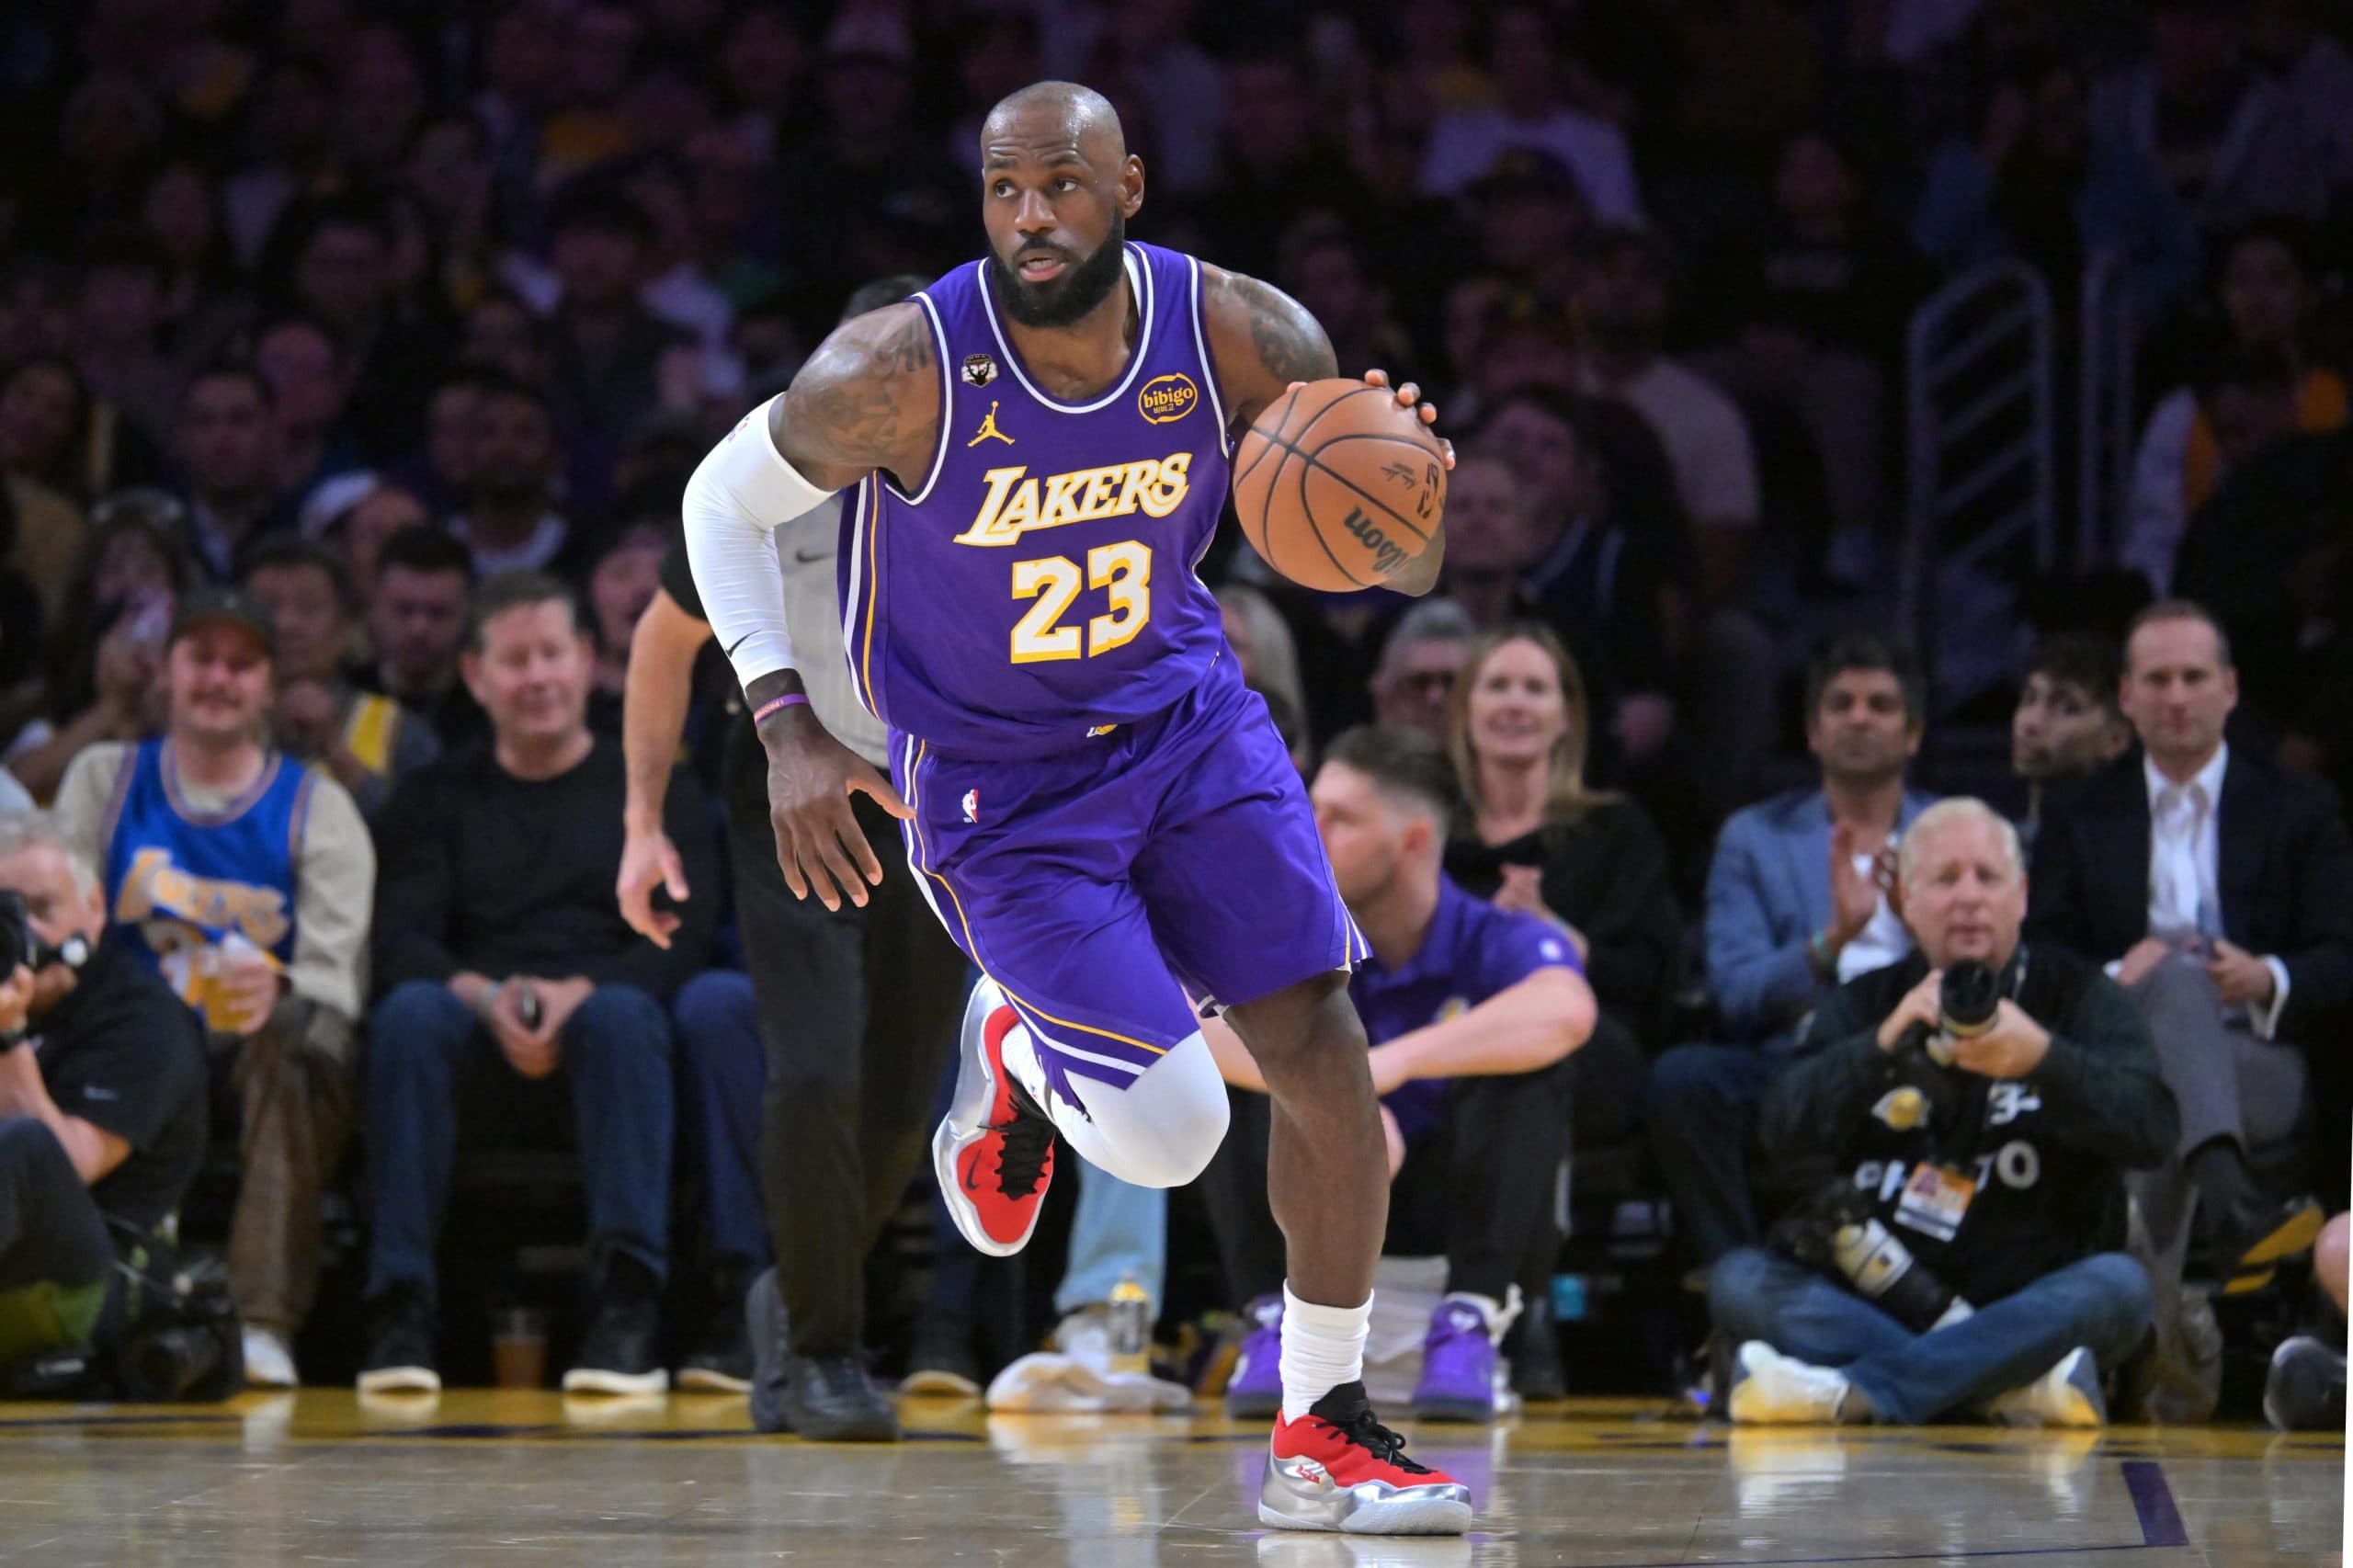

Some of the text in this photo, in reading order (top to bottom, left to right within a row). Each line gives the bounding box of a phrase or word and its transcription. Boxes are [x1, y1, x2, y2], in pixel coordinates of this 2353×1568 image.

[1143, 387, 1194, 407] bibigo
[952, 452, 1193, 547] LAKERS
[1344, 505, 1409, 575] ilson
[1010, 540, 1152, 665] 23
